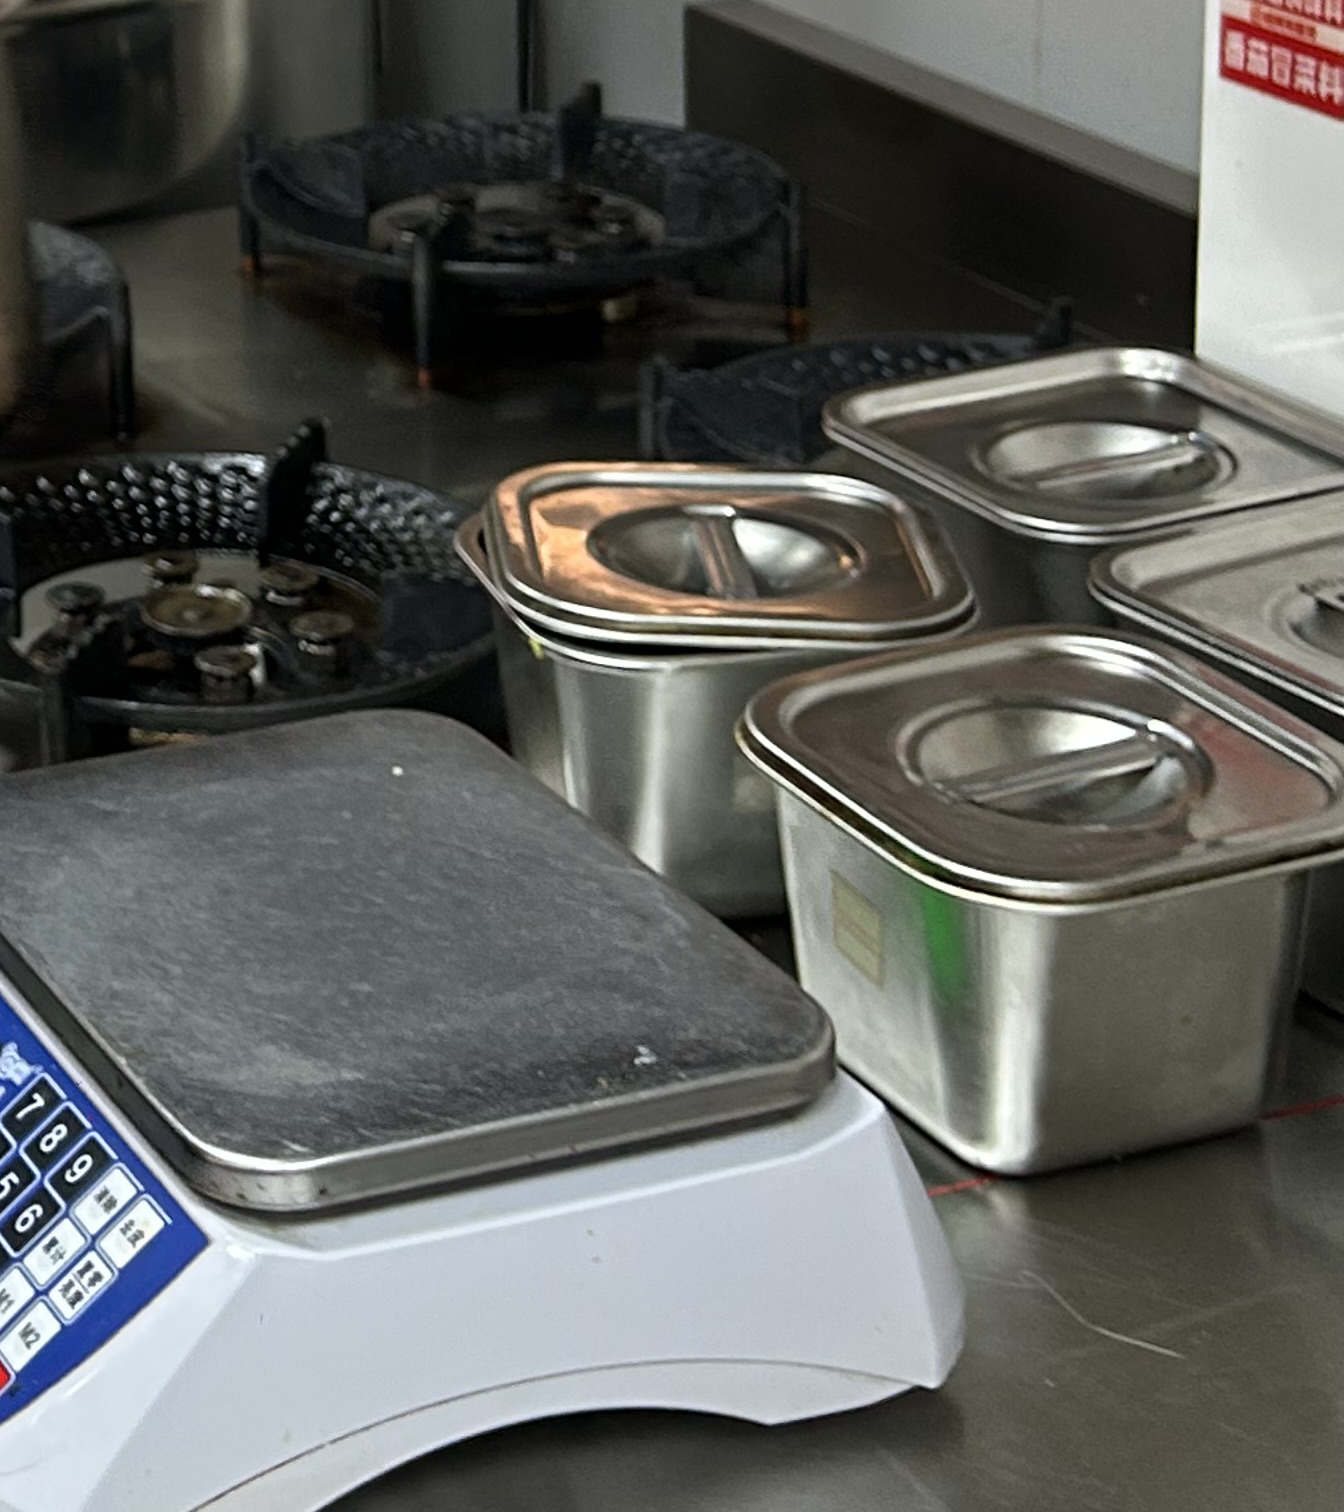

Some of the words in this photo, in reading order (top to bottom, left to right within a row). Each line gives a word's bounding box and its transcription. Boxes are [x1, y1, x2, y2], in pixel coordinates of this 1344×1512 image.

[15, 1092, 45, 1120] 7
[39, 1123, 68, 1153] 8
[64, 1154, 93, 1183] 9
[14, 1203, 44, 1233] 6
[19, 1322, 41, 1350] M2
